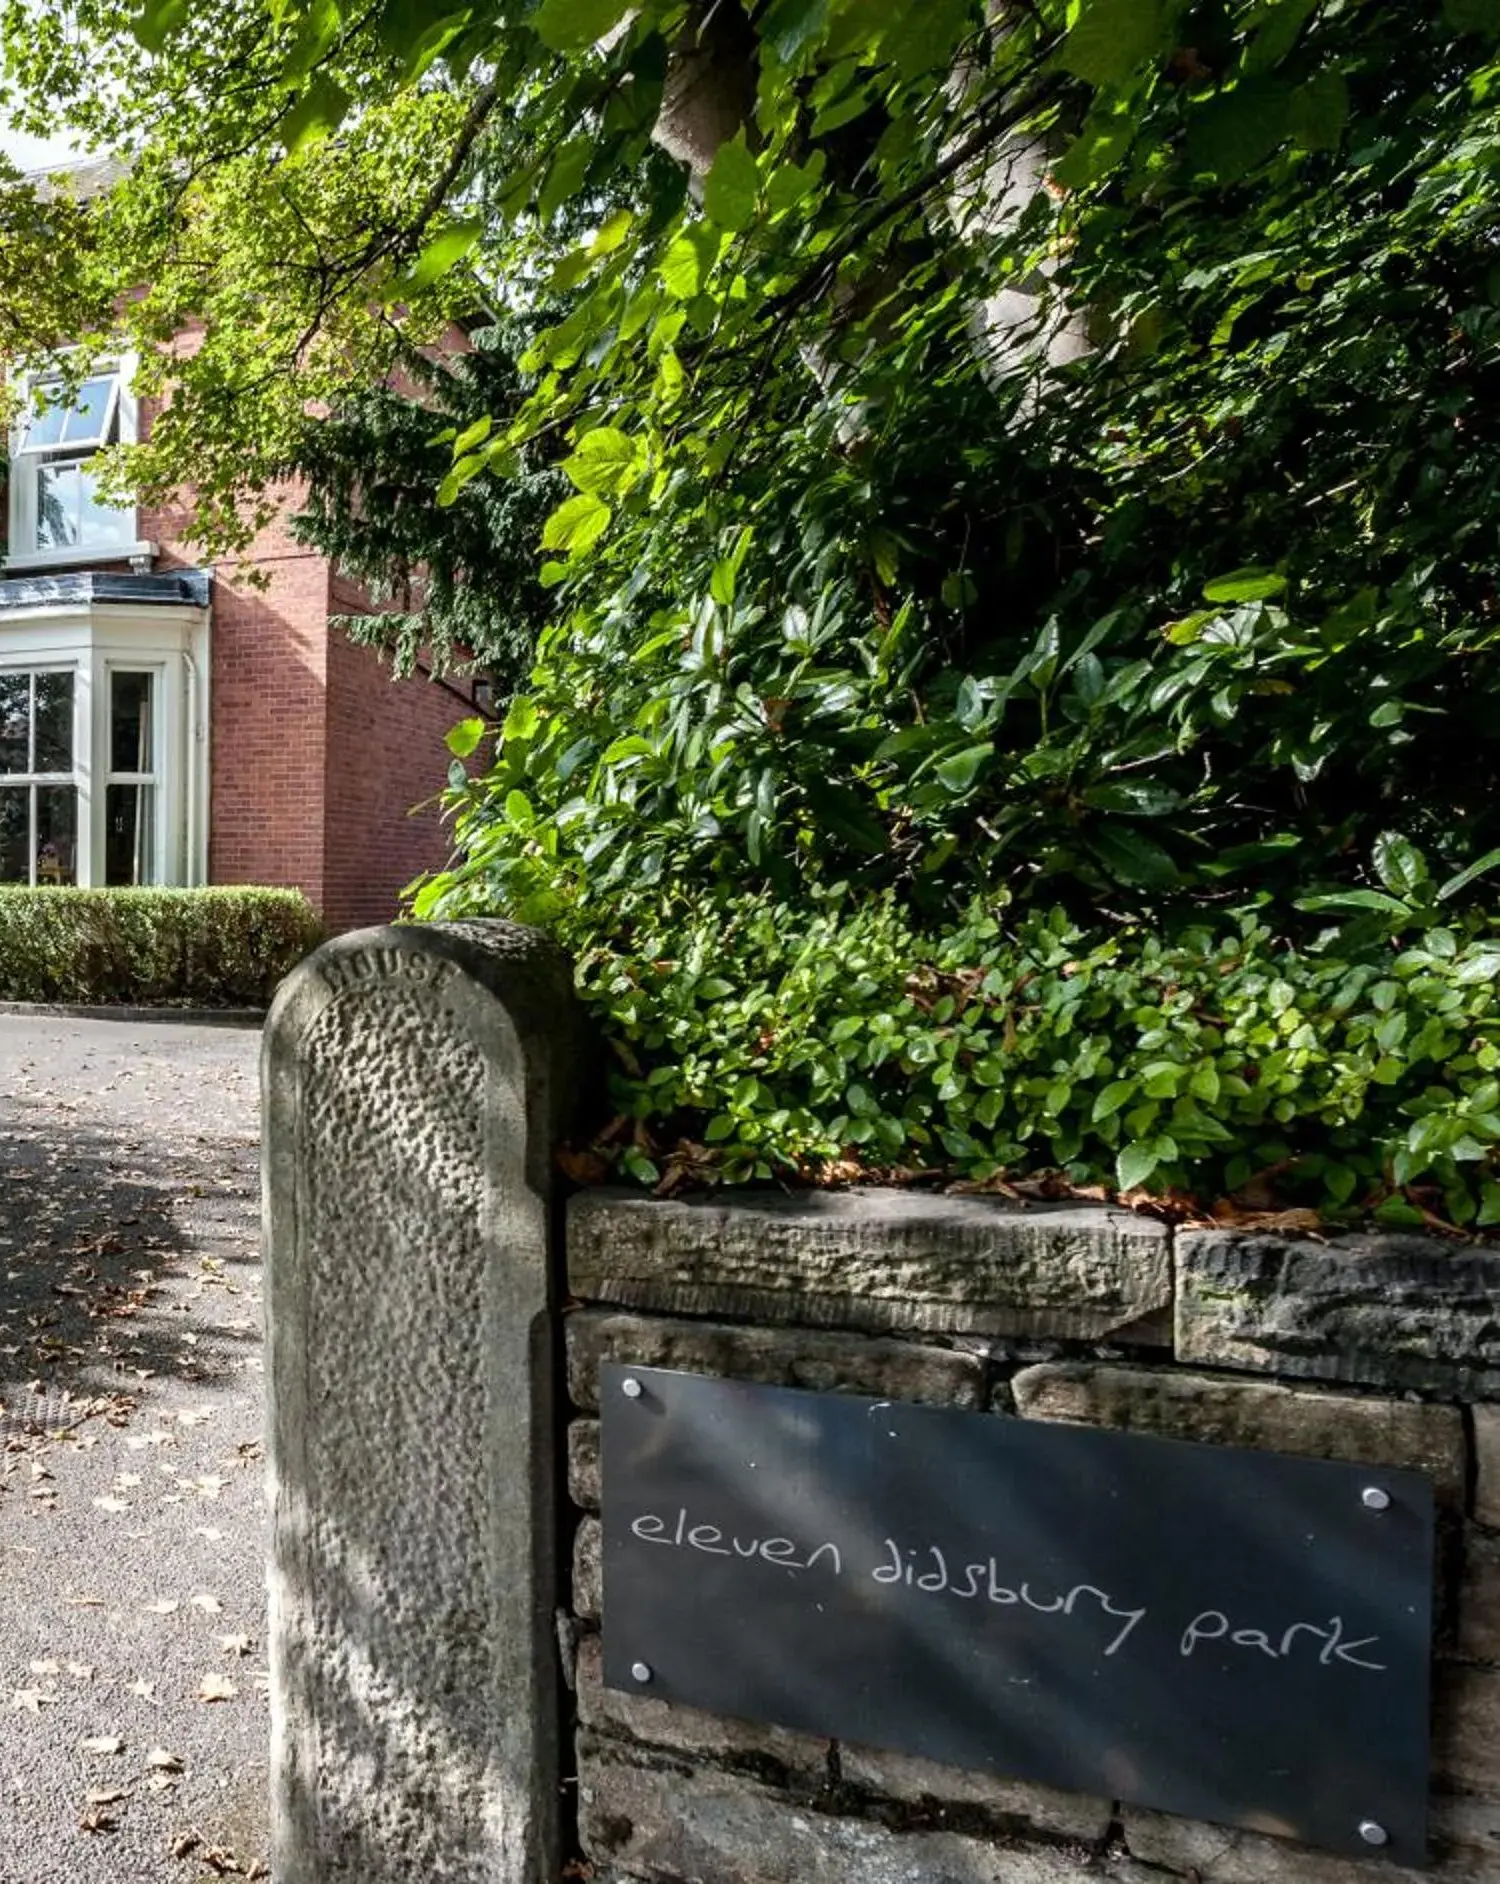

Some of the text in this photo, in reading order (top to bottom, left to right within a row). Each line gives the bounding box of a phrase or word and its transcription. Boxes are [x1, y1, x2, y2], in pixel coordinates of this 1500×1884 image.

[316, 947, 459, 994] HOUSE
[631, 1507, 1387, 1671] eleven didsbury park
